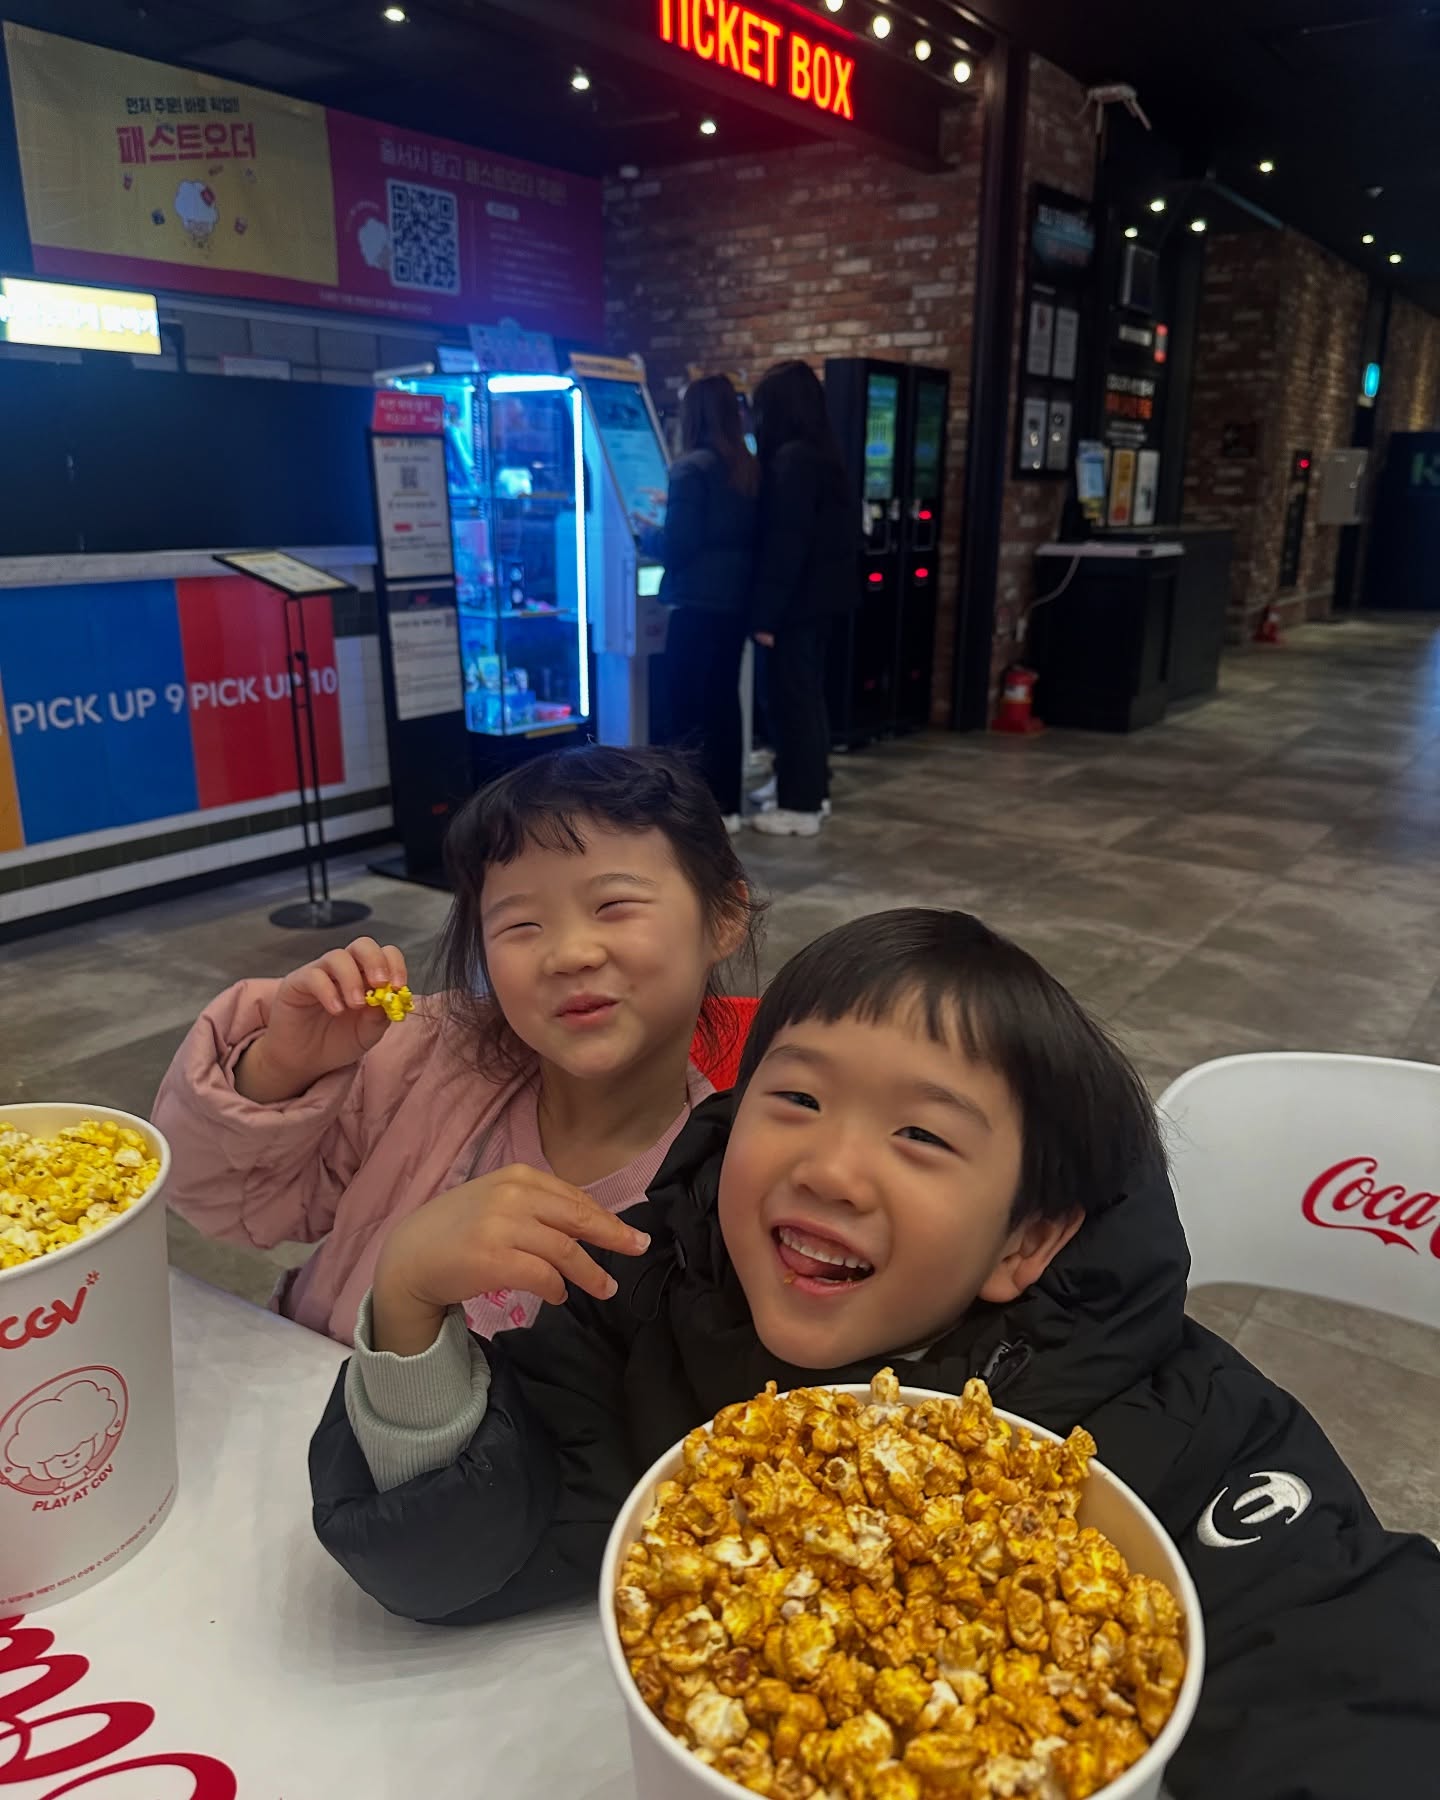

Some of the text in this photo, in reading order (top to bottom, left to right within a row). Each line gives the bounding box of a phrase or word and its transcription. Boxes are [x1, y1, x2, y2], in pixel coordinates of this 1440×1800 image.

[660, 0, 855, 120] TICKET BOX
[126, 96, 152, 115] 먼저
[116, 121, 257, 164] 패스트오더
[11, 694, 102, 735] PICK
[108, 687, 157, 722] UP
[164, 684, 186, 713] 9
[190, 666, 338, 710] PICK UP 10
[0, 1285, 88, 1350] CGV
[31, 1462, 114, 1512] PLAY AT CGV
